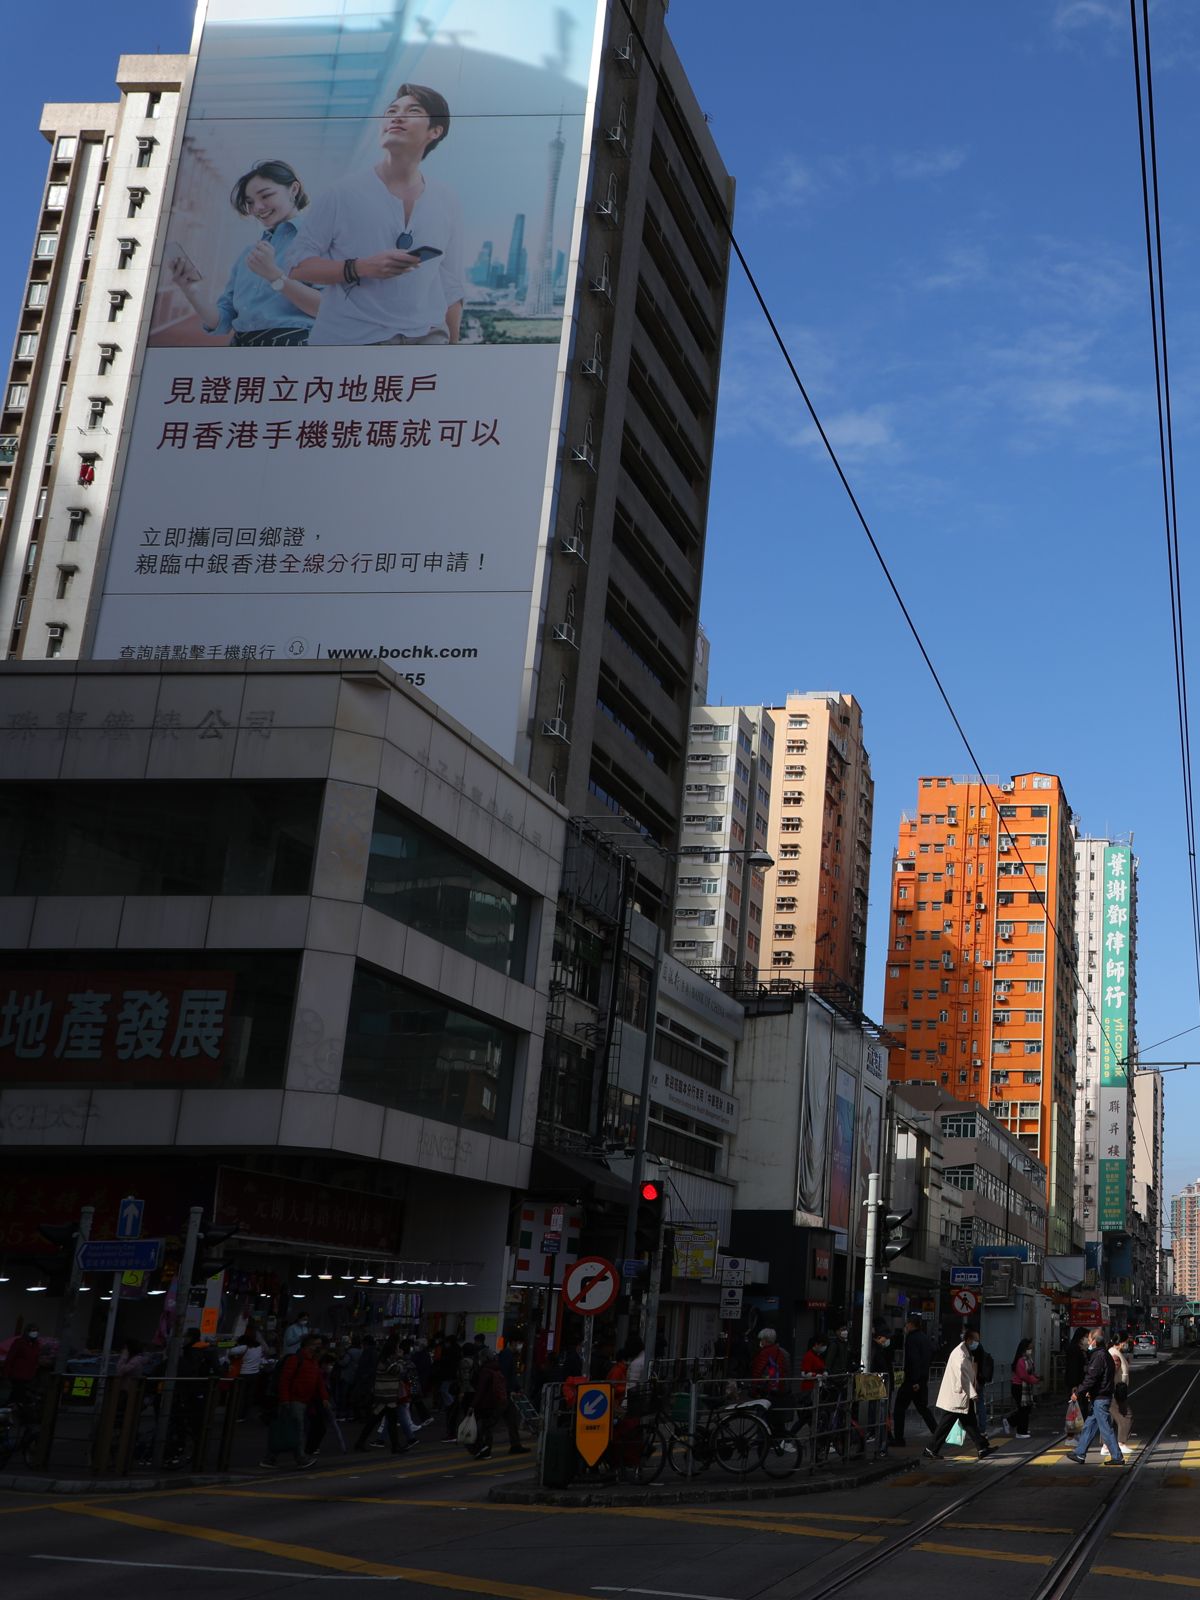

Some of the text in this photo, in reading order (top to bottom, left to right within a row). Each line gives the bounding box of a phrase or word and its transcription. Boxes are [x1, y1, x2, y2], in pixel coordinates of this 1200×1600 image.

[155, 418, 502, 451] 用香港手機號碼就可以
[328, 644, 479, 661] www.bochk.com
[398, 672, 426, 688] 55
